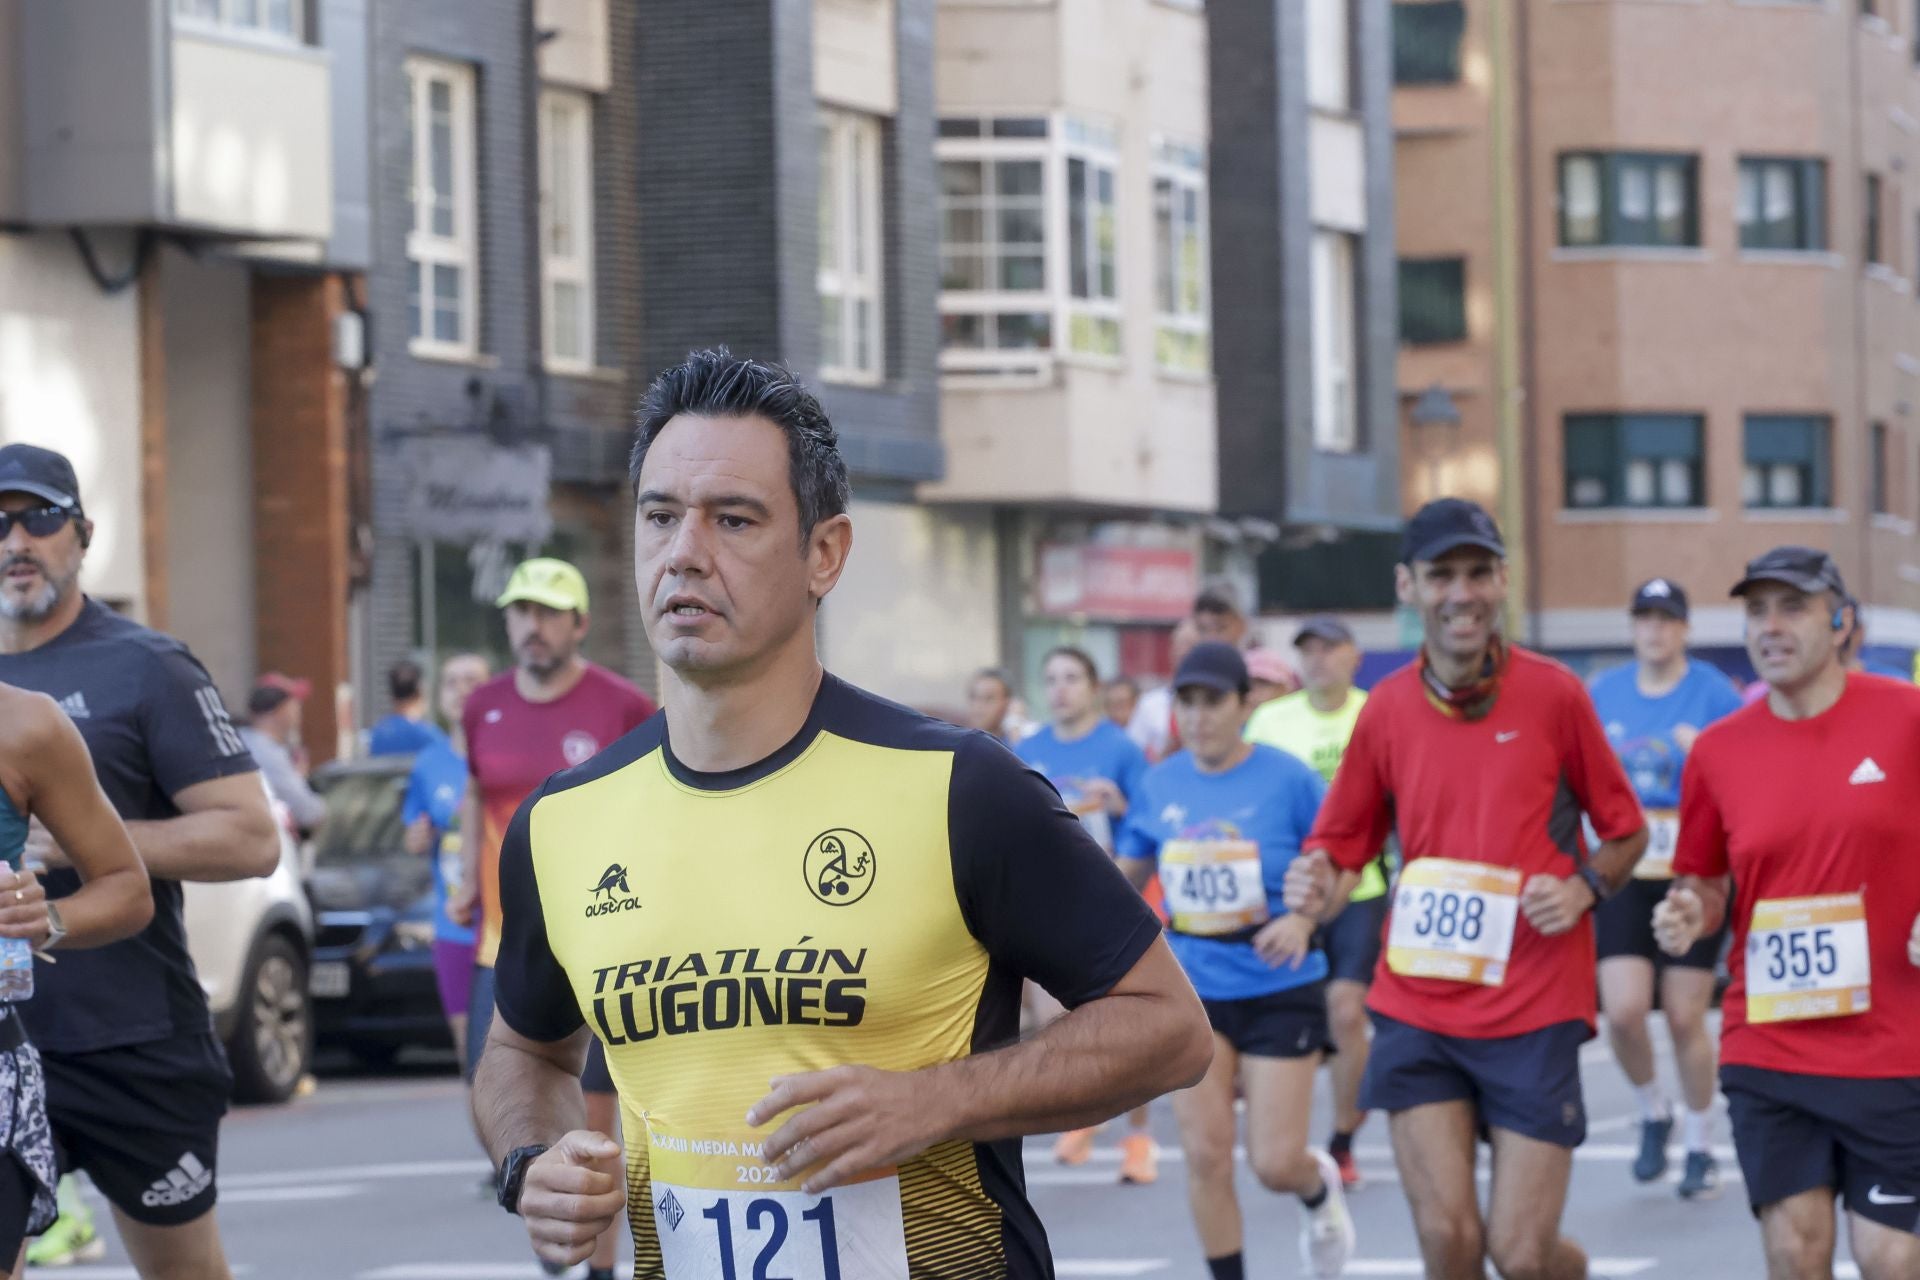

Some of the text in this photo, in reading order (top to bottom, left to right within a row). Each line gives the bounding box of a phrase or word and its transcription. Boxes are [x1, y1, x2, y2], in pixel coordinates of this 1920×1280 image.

[1181, 866, 1238, 903] 403
[1415, 891, 1484, 941] 388
[593, 936, 867, 994] TRIATLÓN
[1766, 929, 1837, 980] 355
[593, 977, 866, 1045] LUGONES
[691, 1140, 739, 1156] MEDIA
[736, 1166, 780, 1184] 202
[703, 1197, 841, 1280] 121
